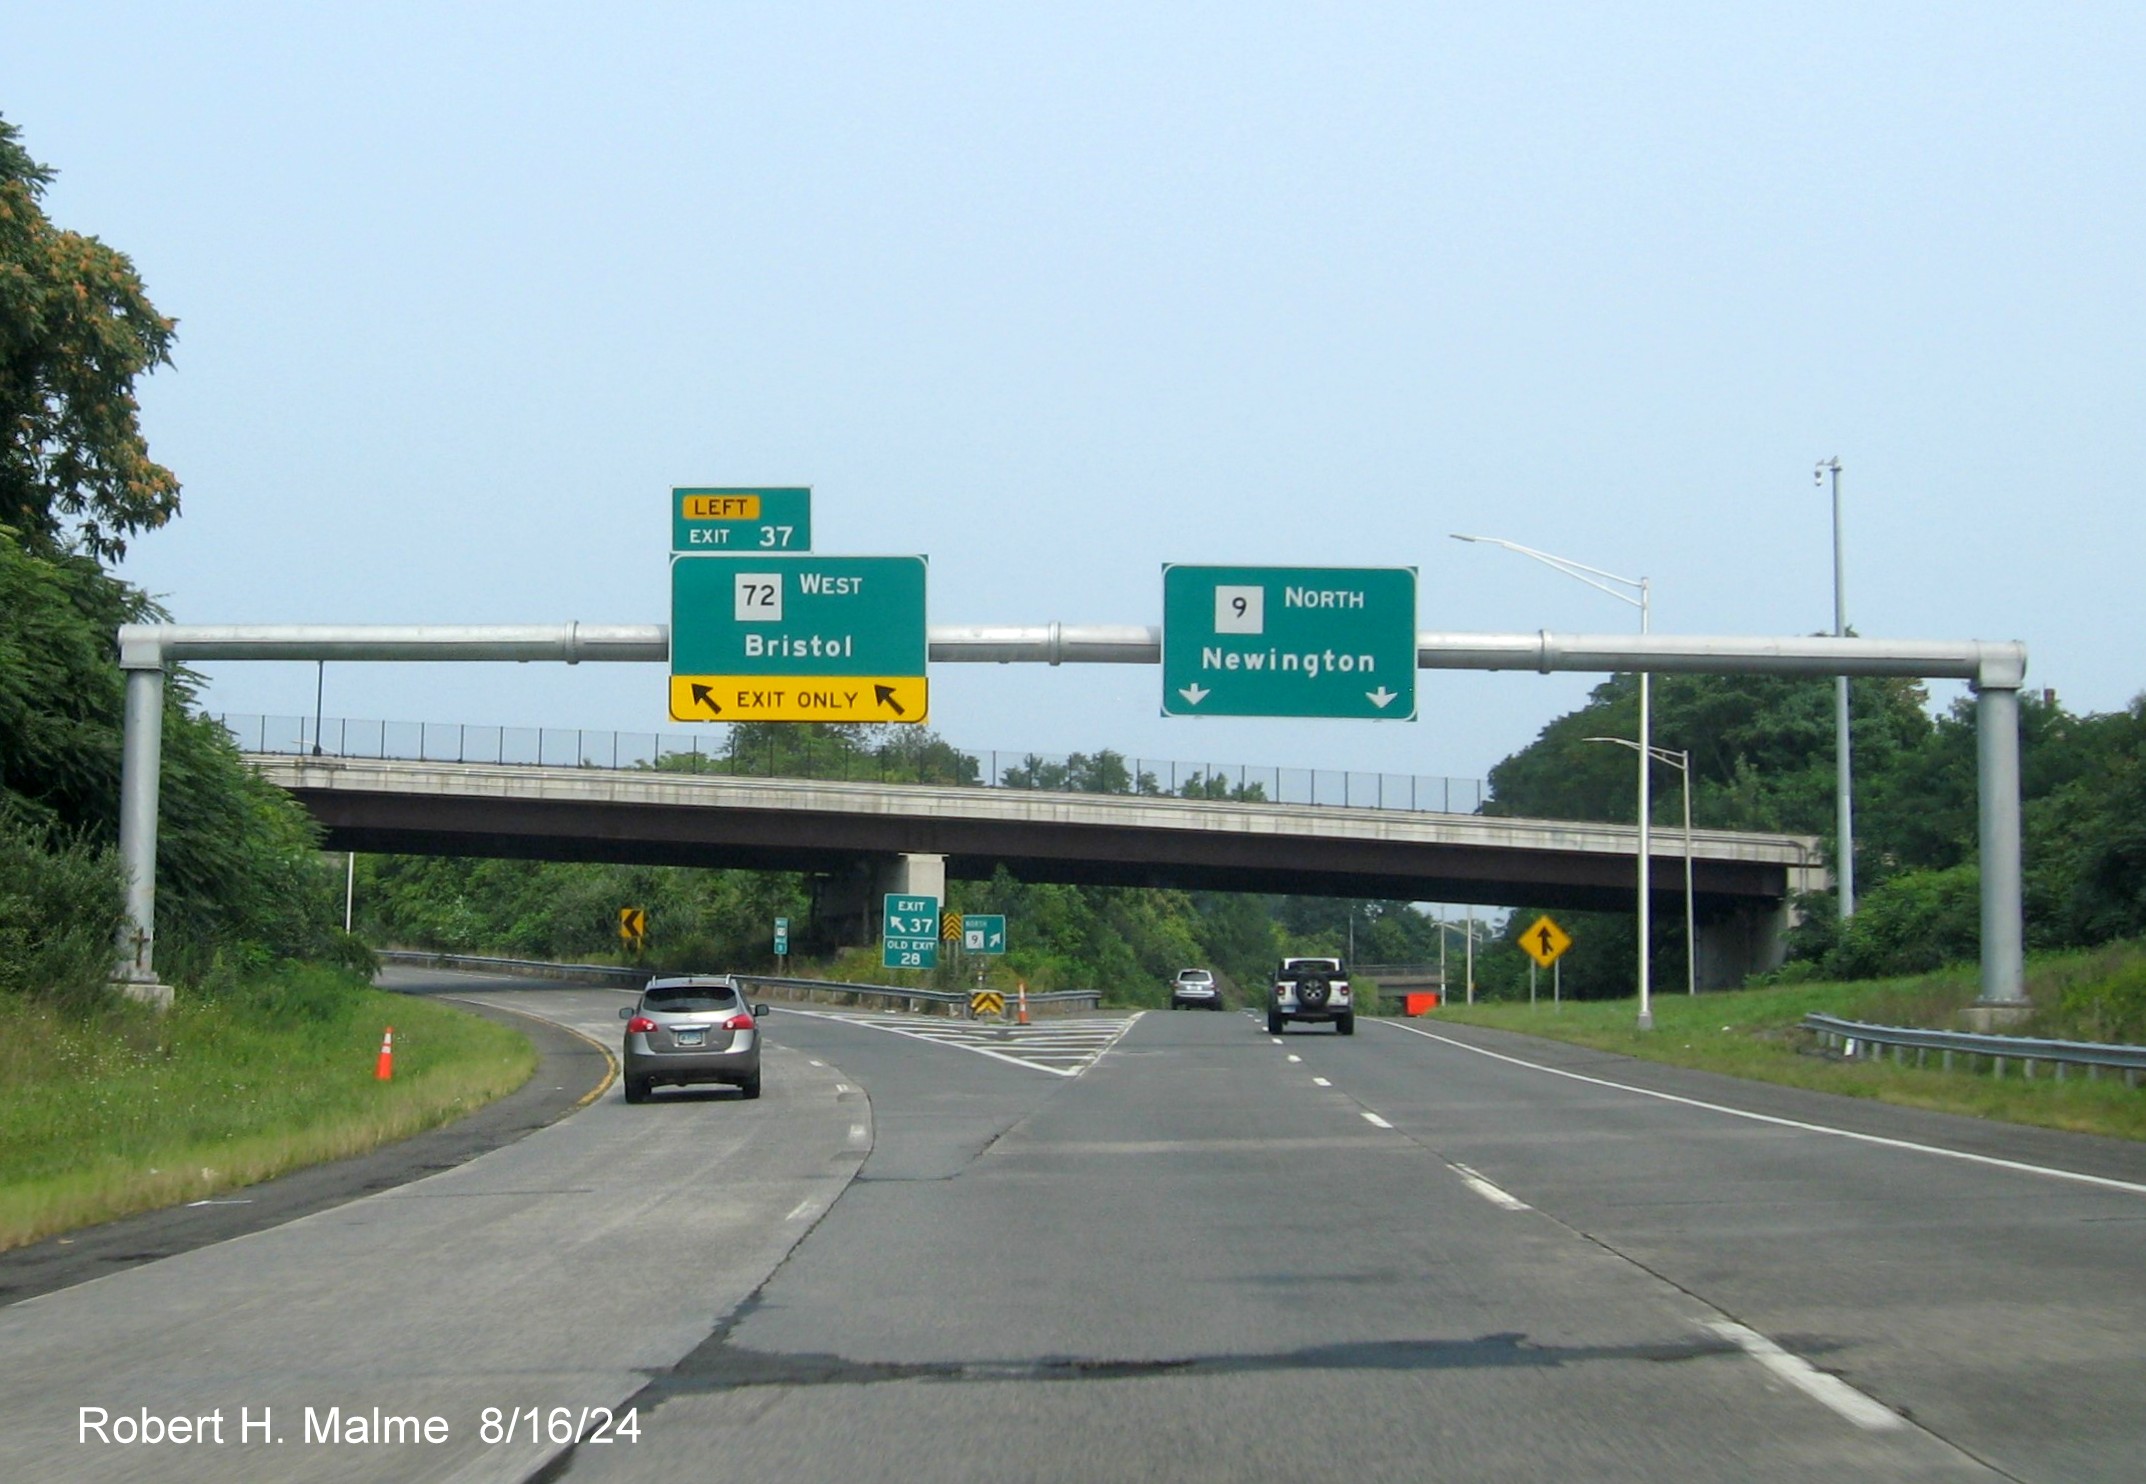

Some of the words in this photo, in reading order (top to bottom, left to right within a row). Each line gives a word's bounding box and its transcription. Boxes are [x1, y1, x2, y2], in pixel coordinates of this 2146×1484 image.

[694, 499, 748, 516] LEFT
[689, 529, 730, 544] EXIT
[759, 526, 793, 547] 37
[742, 585, 775, 606] 72
[800, 573, 862, 595] WEST
[1232, 597, 1247, 618] 9
[1285, 586, 1364, 609] NORTH
[745, 634, 852, 657] Bristol
[1203, 647, 1375, 678] Newington
[737, 691, 785, 708] EXIT
[797, 691, 858, 708] ONLY
[898, 901, 925, 911] EXIT
[910, 918, 933, 933] 37
[887, 941, 908, 950] OLD
[912, 942, 934, 950] EXIT
[971, 935, 978, 944] 9
[901, 953, 920, 965] 28
